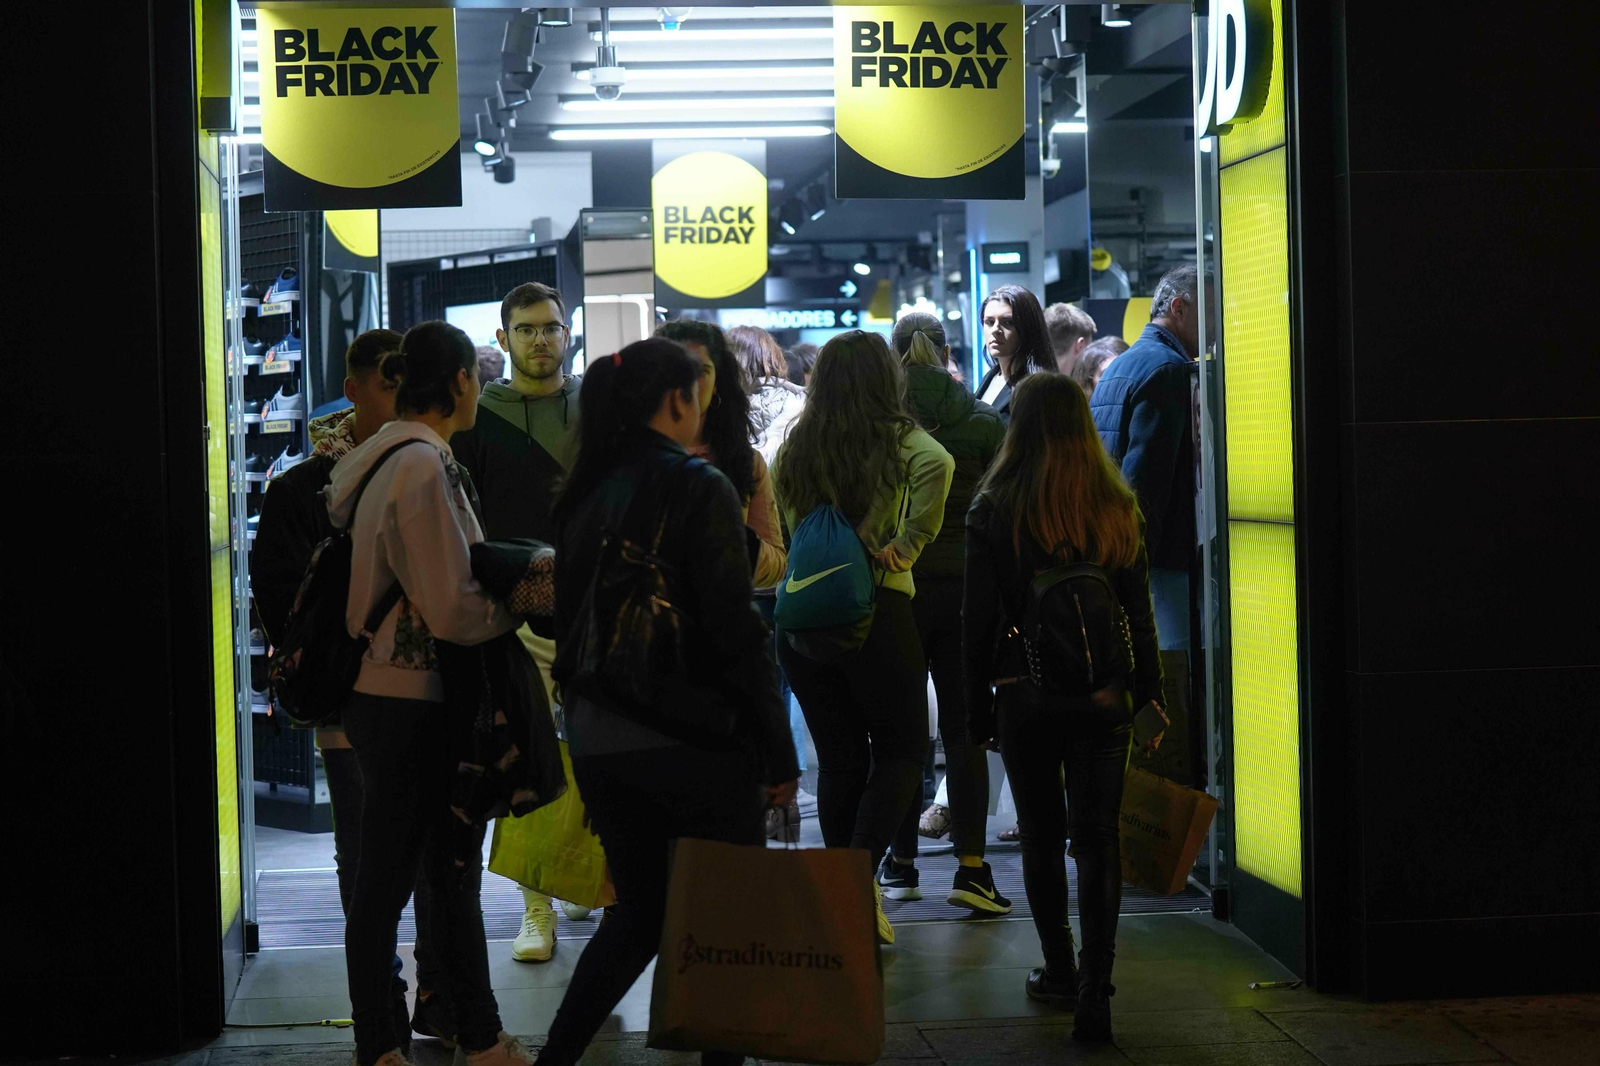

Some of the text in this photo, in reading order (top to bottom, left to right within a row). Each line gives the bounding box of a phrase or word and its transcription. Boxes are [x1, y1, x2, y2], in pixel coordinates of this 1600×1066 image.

[275, 26, 439, 63] BLACK
[852, 22, 1008, 56] BLACK
[276, 61, 441, 98] FRIDAY
[852, 56, 1008, 89] FRIDAY
[663, 206, 754, 225] BLACK
[663, 226, 755, 244] FRIDAY
[695, 941, 843, 971] stradivarius
